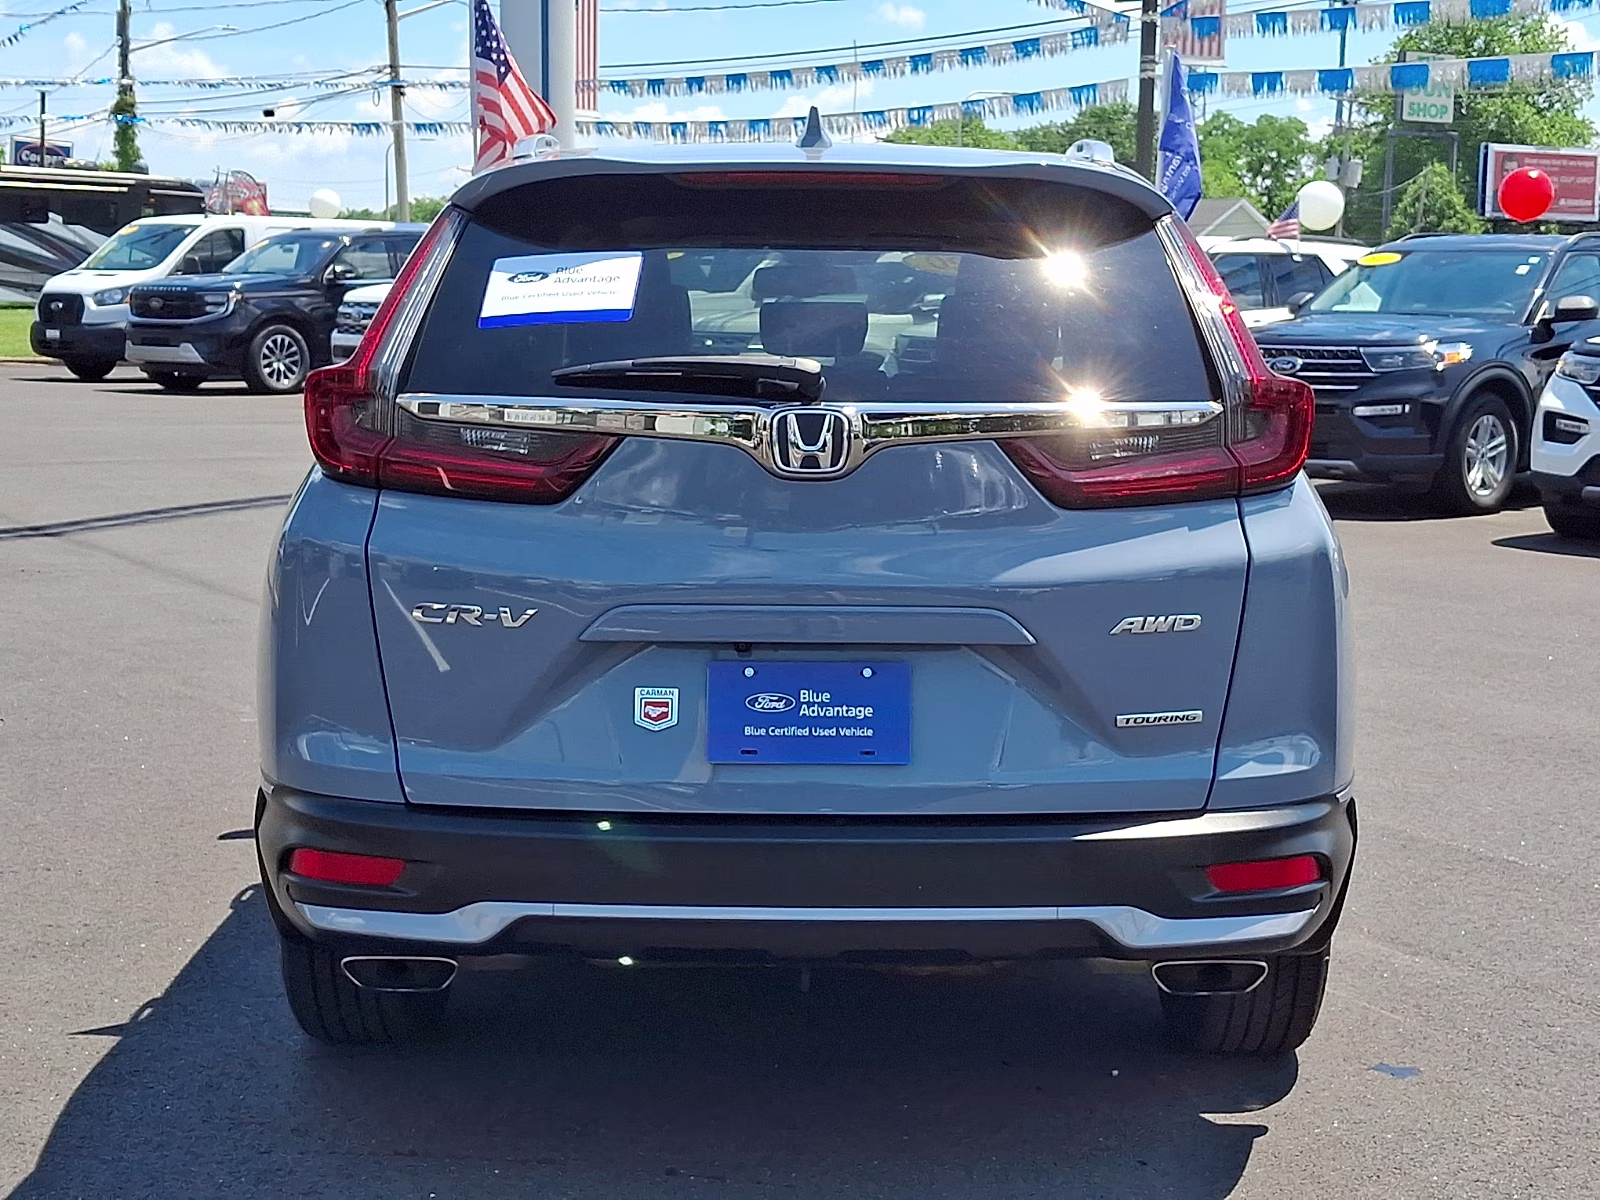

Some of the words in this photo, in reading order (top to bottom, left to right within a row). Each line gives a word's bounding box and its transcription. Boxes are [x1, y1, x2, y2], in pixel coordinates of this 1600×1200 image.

[1408, 101, 1448, 119] SHOP
[556, 266, 584, 275] Blue
[553, 275, 621, 284] Advantage
[412, 602, 539, 628] CR-V
[1110, 614, 1202, 635] AWD
[754, 694, 787, 709] Ford
[800, 689, 831, 702] Blue
[799, 704, 874, 720] Advantage
[1122, 714, 1197, 725] TOURING
[744, 726, 767, 736] Blue
[768, 726, 809, 736] Certified
[811, 726, 837, 737] Used
[838, 727, 874, 737] Vehicle
